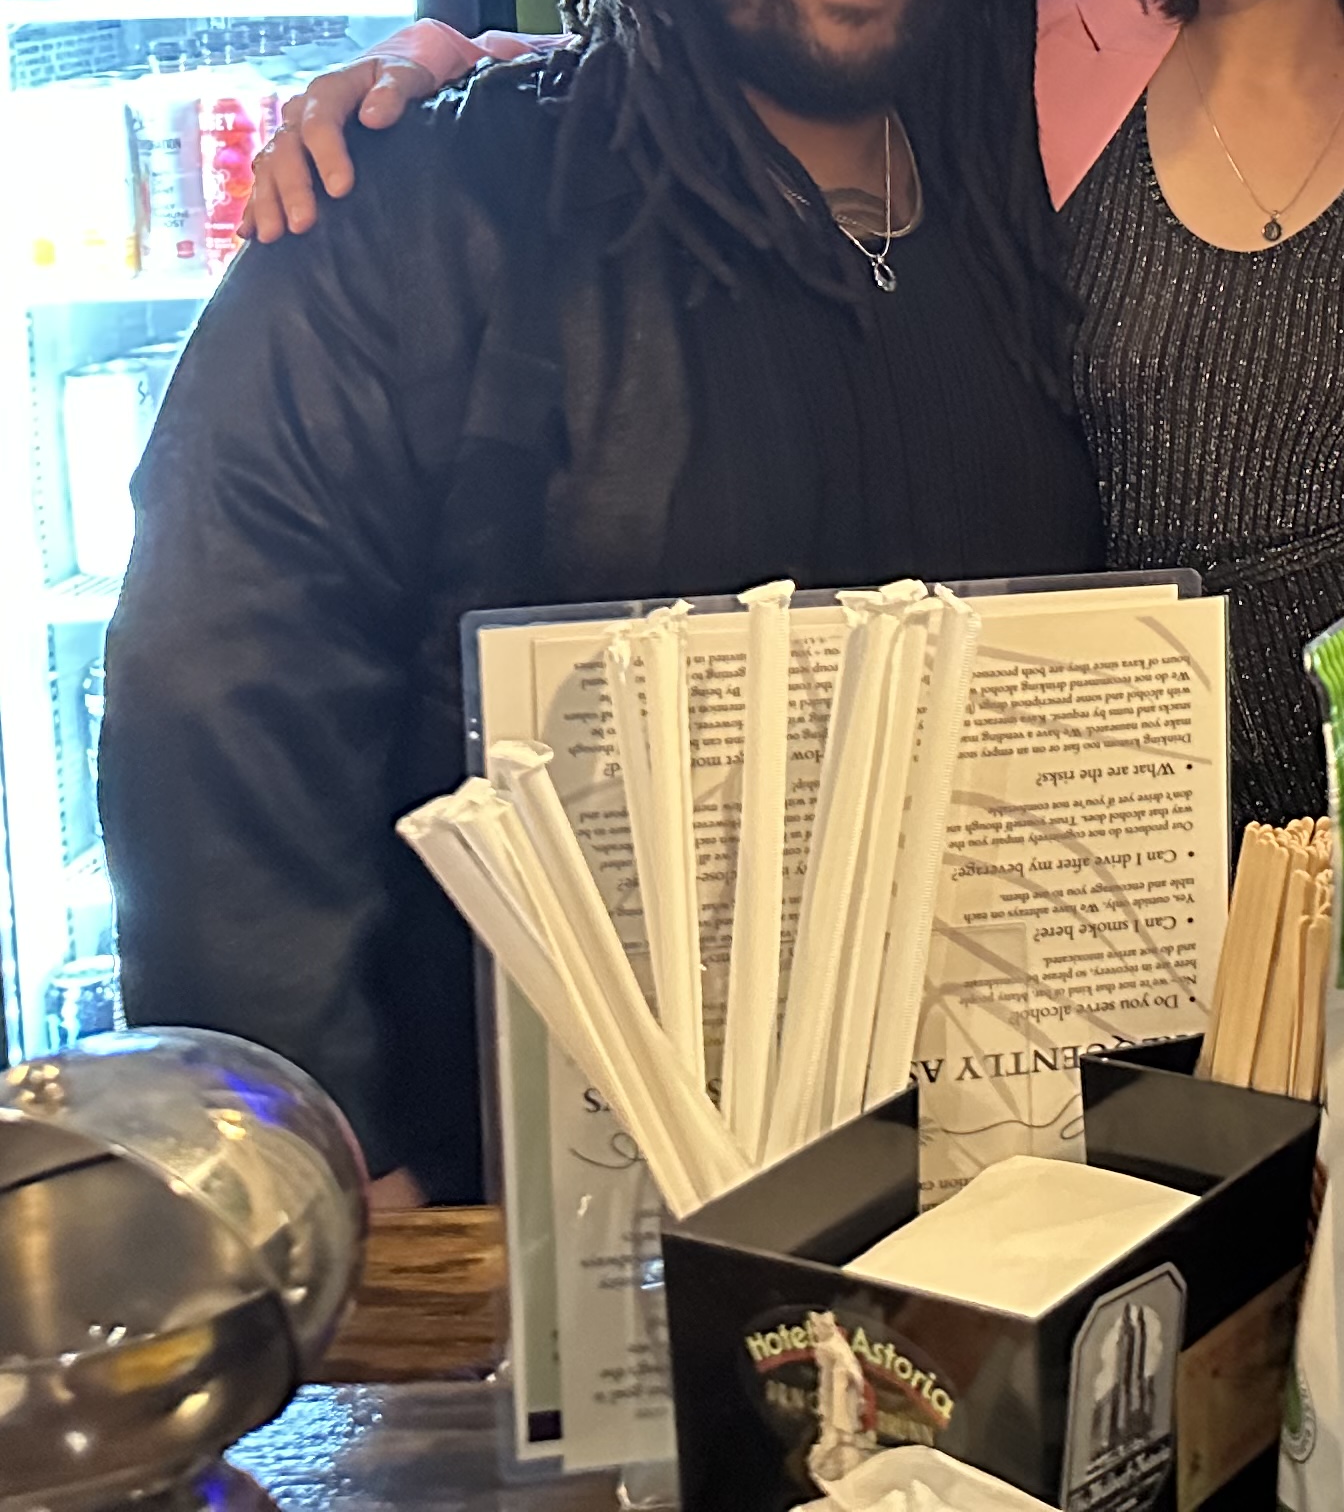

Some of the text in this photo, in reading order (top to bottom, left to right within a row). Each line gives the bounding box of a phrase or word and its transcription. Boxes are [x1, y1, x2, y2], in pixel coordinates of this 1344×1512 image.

[1021, 655, 1190, 679] hours of kava since they are both
[982, 671, 1189, 697] We do not drinking alcohol
[1167, 686, 1190, 697] with
[1076, 694, 1101, 703] some
[1105, 692, 1124, 702] and
[1127, 688, 1163, 700] alcohol
[1093, 702, 1191, 720] snacks and by
[982, 718, 1191, 743] make you We have vending
[981, 746, 1013, 759] empty
[1016, 747, 1029, 755] an
[1063, 743, 1080, 753] fast
[1036, 762, 1174, 786] What are the risks?
[1052, 794, 1163, 811] drive yet if not
[964, 806, 1192, 833] way that alcohol Trust though
[1172, 821, 1193, 830] Our
[951, 849, 1177, 881] Can I drive after my beverage?
[1067, 887, 1087, 897] you
[963, 904, 1099, 923] We have each
[1033, 916, 1177, 942] Can I smoke here?
[1107, 943, 1196, 959] and do not arrive
[1042, 968, 1072, 983] please
[1076, 1001, 1115, 1013] serve
[1120, 993, 1150, 1008] you
[1154, 995, 1178, 1009] Do
[748, 1319, 818, 1361] Hotel
[851, 1327, 954, 1418] Astoria
